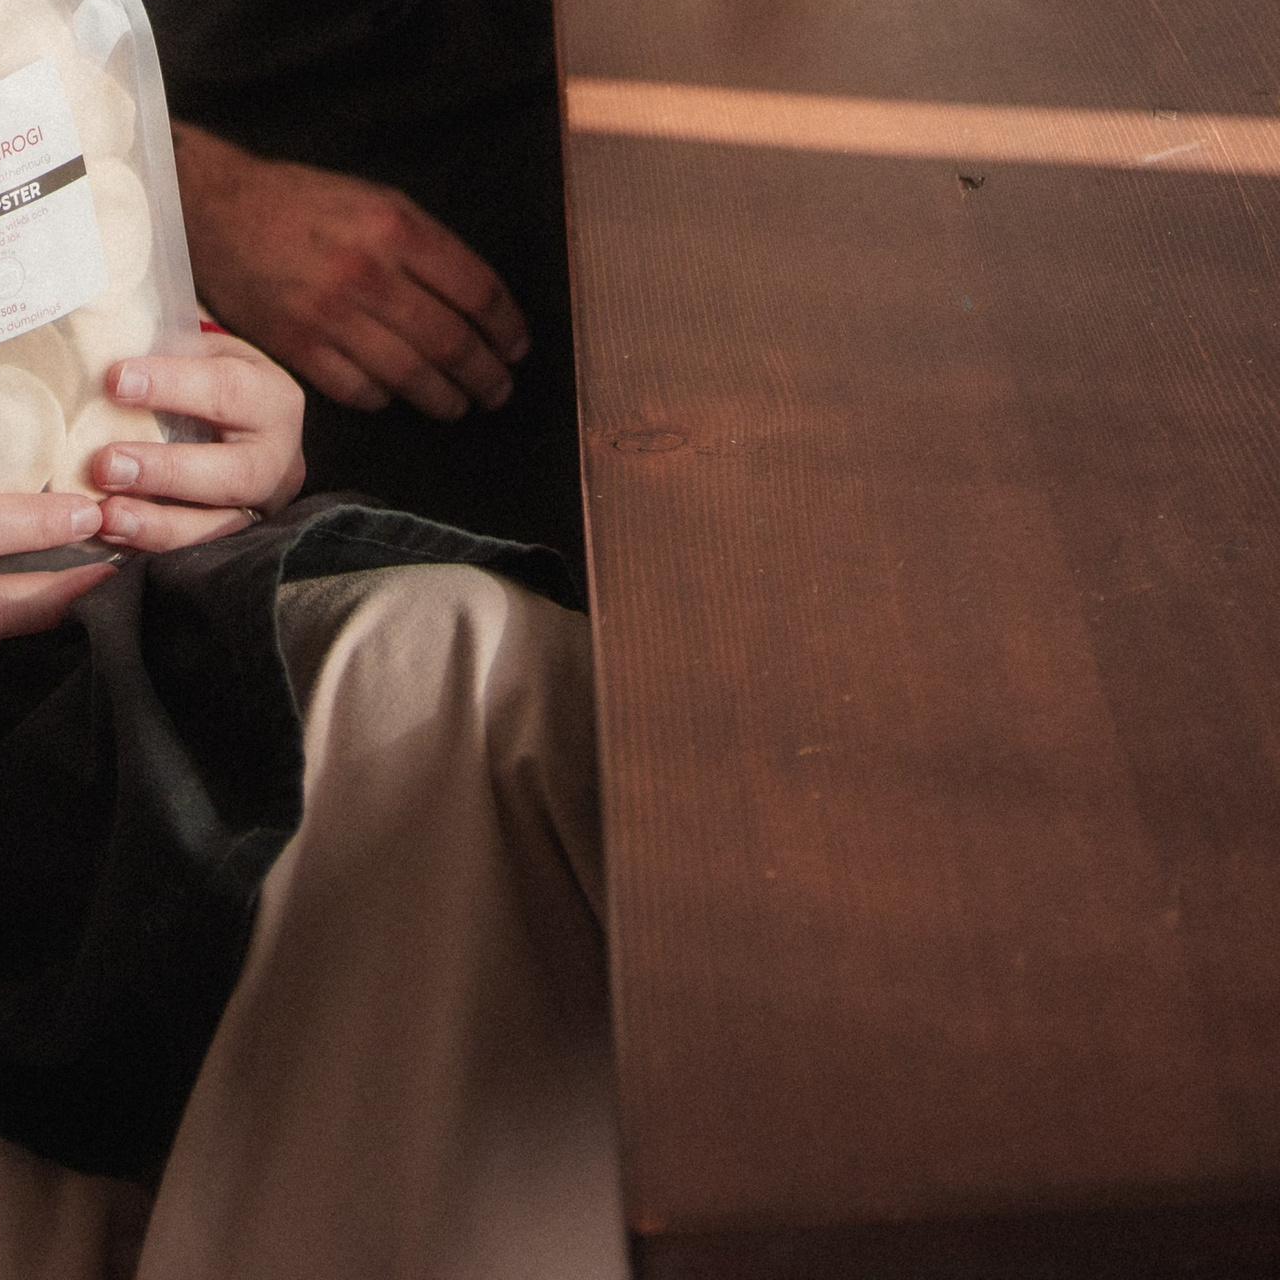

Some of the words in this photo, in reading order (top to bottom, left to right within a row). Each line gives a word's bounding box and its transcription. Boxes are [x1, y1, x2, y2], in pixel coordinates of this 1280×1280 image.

[32, 207, 49, 221] och
[0, 303, 18, 318] 500
[19, 302, 27, 313] g
[6, 302, 62, 332] dumplings
